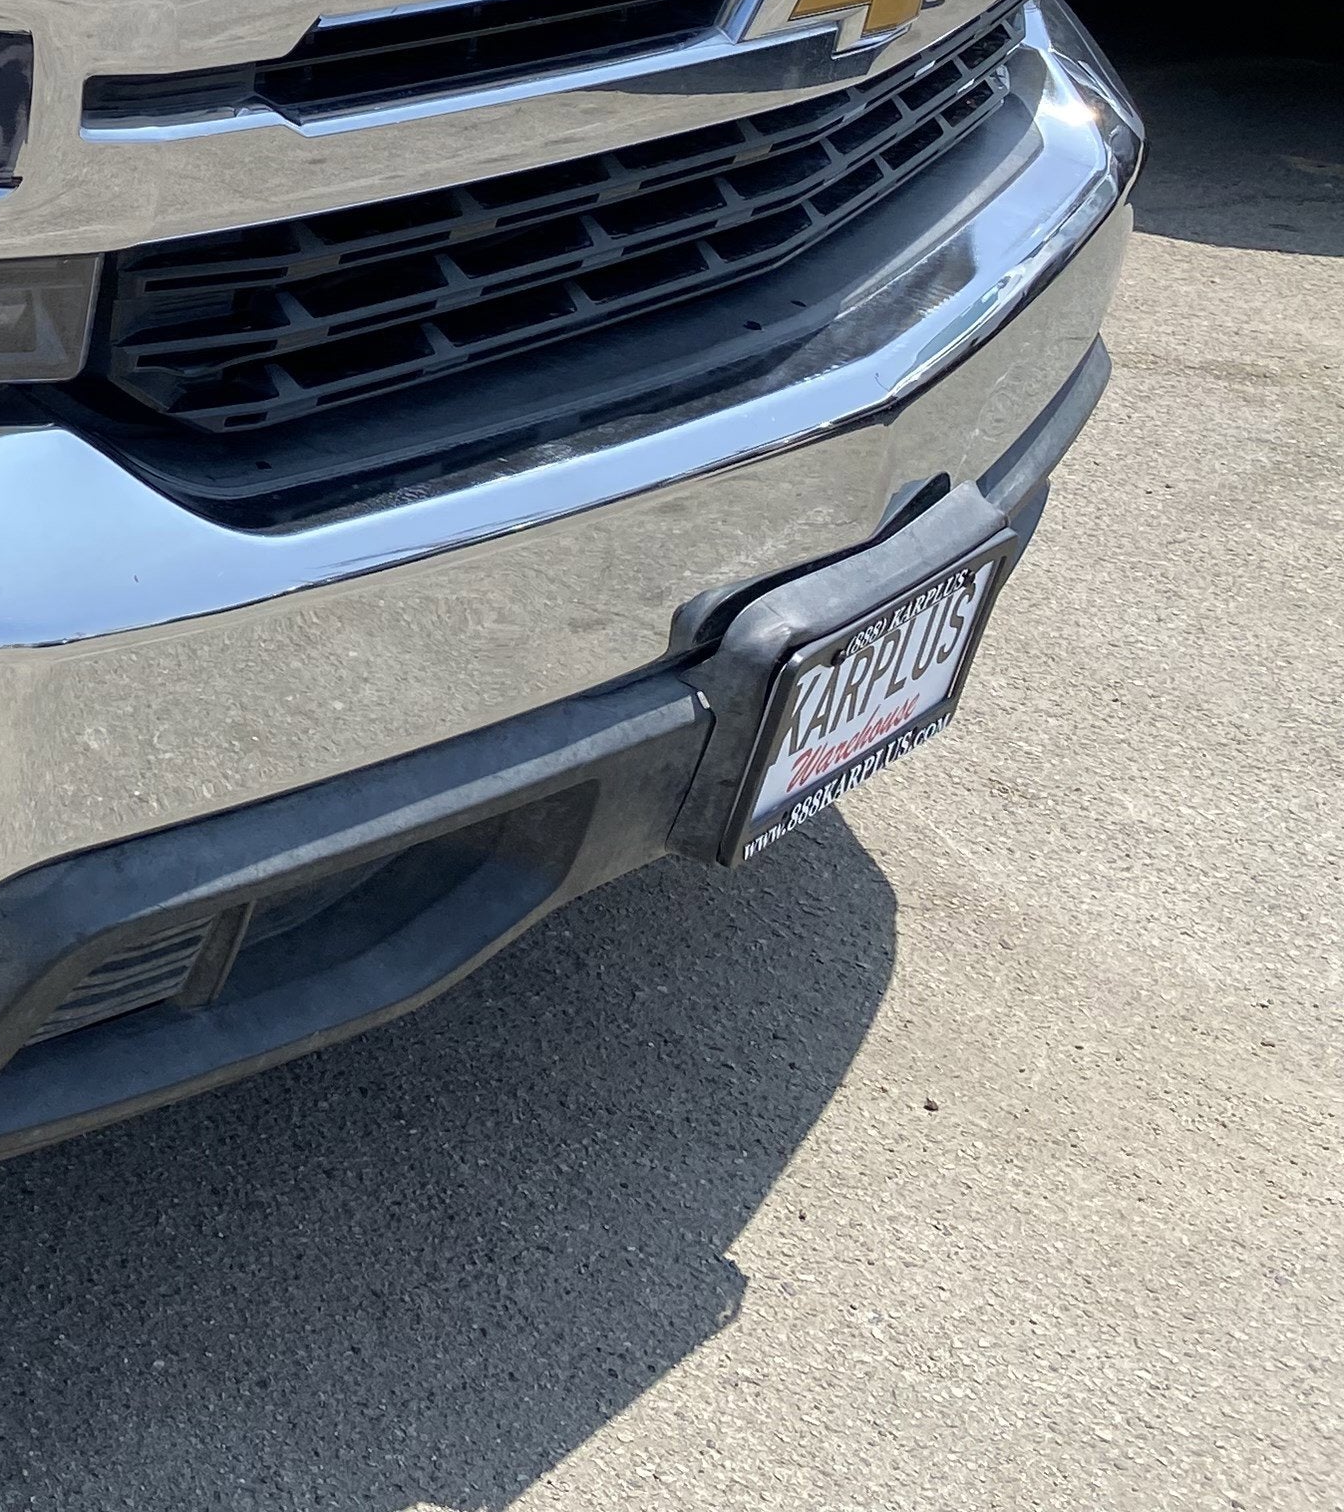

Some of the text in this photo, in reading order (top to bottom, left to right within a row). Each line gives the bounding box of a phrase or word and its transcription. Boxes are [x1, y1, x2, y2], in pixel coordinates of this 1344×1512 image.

[844, 569, 969, 657] (888) KARPLUS
[770, 581, 976, 768] KARPLUS
[786, 691, 921, 794] Warehouse
